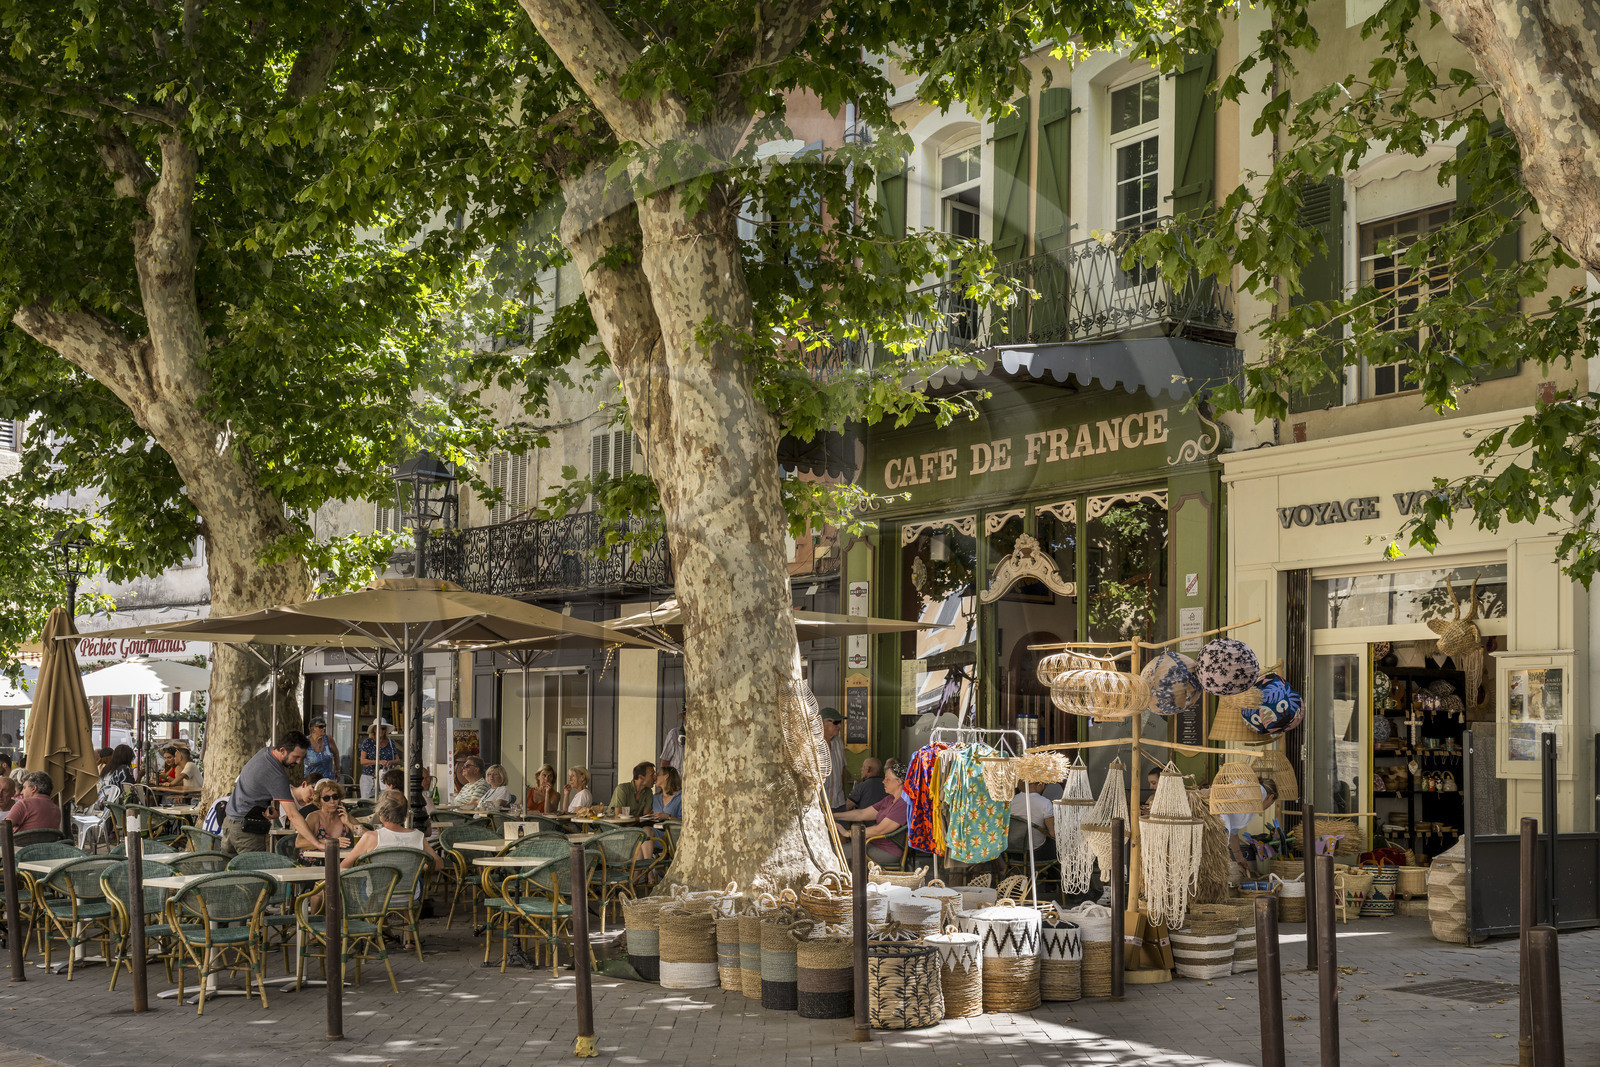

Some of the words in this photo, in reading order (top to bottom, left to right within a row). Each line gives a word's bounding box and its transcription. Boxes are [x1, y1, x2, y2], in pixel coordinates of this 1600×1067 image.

[884, 447, 958, 490] CAFE
[969, 437, 1012, 477] DE
[1024, 408, 1169, 467] FRANCE
[1276, 496, 1380, 530] VOYAGE
[80, 637, 116, 657] Péchés
